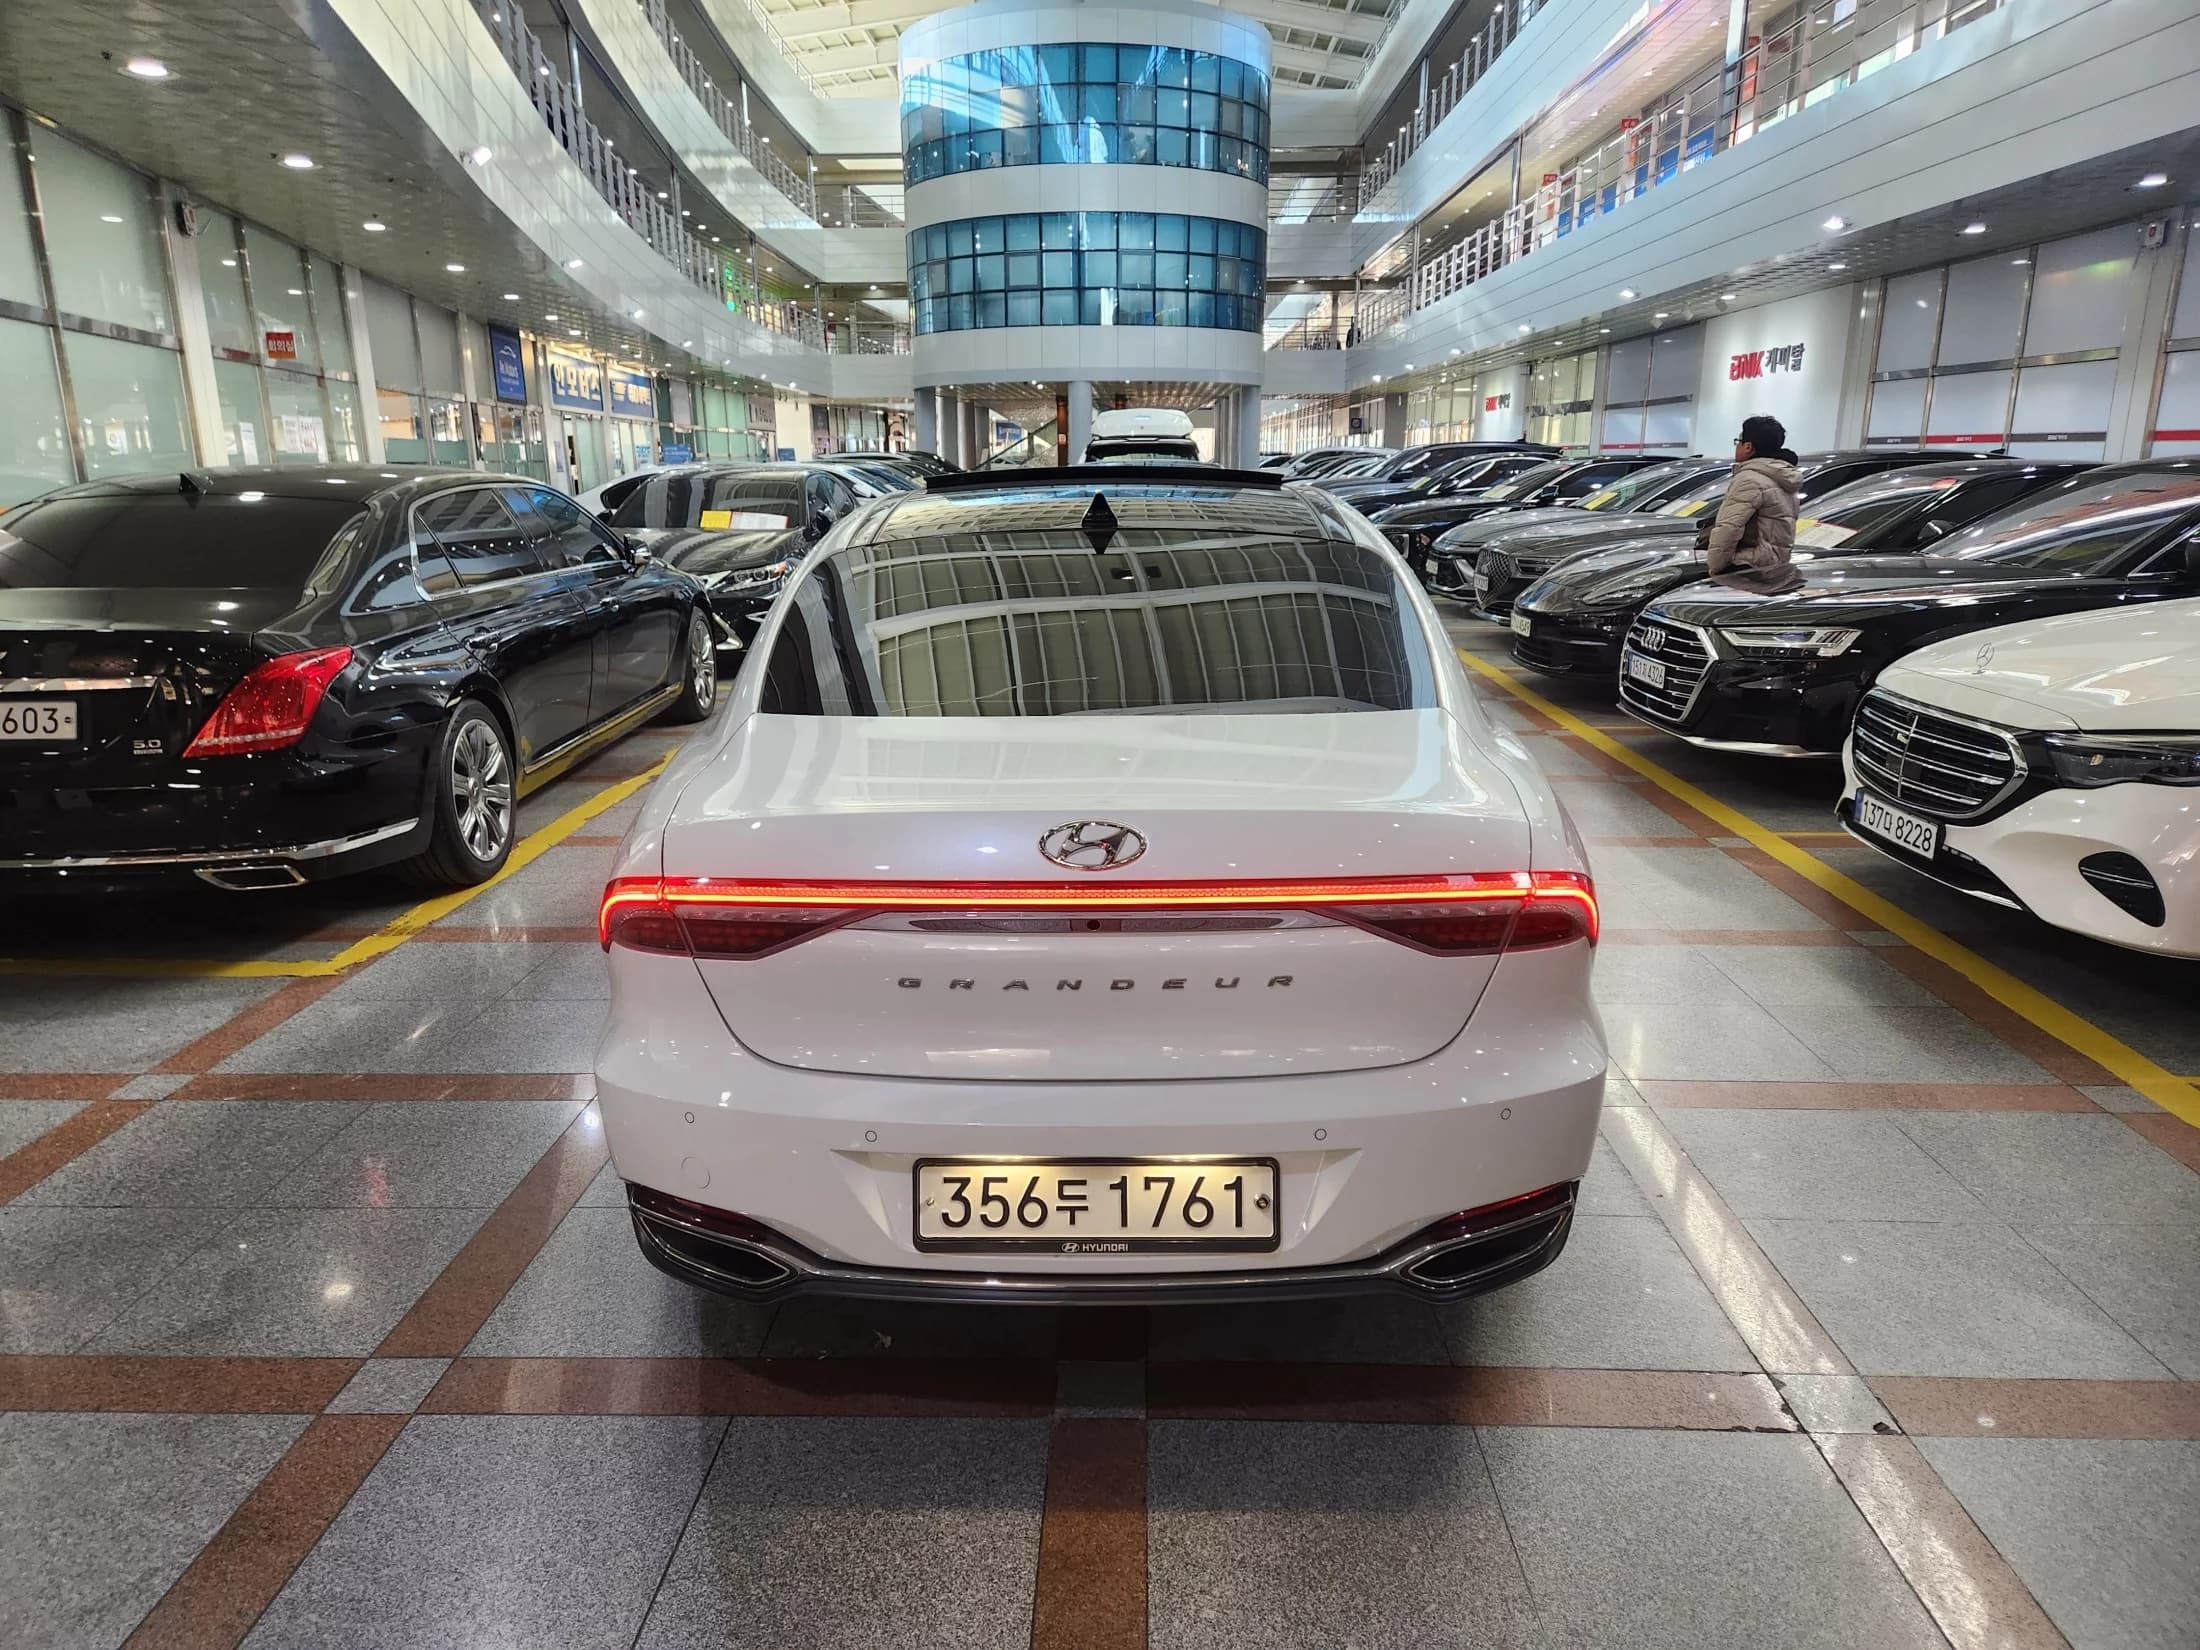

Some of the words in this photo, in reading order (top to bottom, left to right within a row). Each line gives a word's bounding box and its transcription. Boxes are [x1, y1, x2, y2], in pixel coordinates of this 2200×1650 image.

[1765, 342, 1805, 374] 캐피탈
[2, 706, 59, 734] 603
[1863, 800, 1893, 835] 137마
[1895, 816, 1933, 852] 8228
[897, 975, 1294, 990] GRANDEUR
[941, 1176, 1089, 1228] 356두
[1109, 1175, 1243, 1228] 1761
[1082, 1243, 1129, 1252] HYUNDAI
